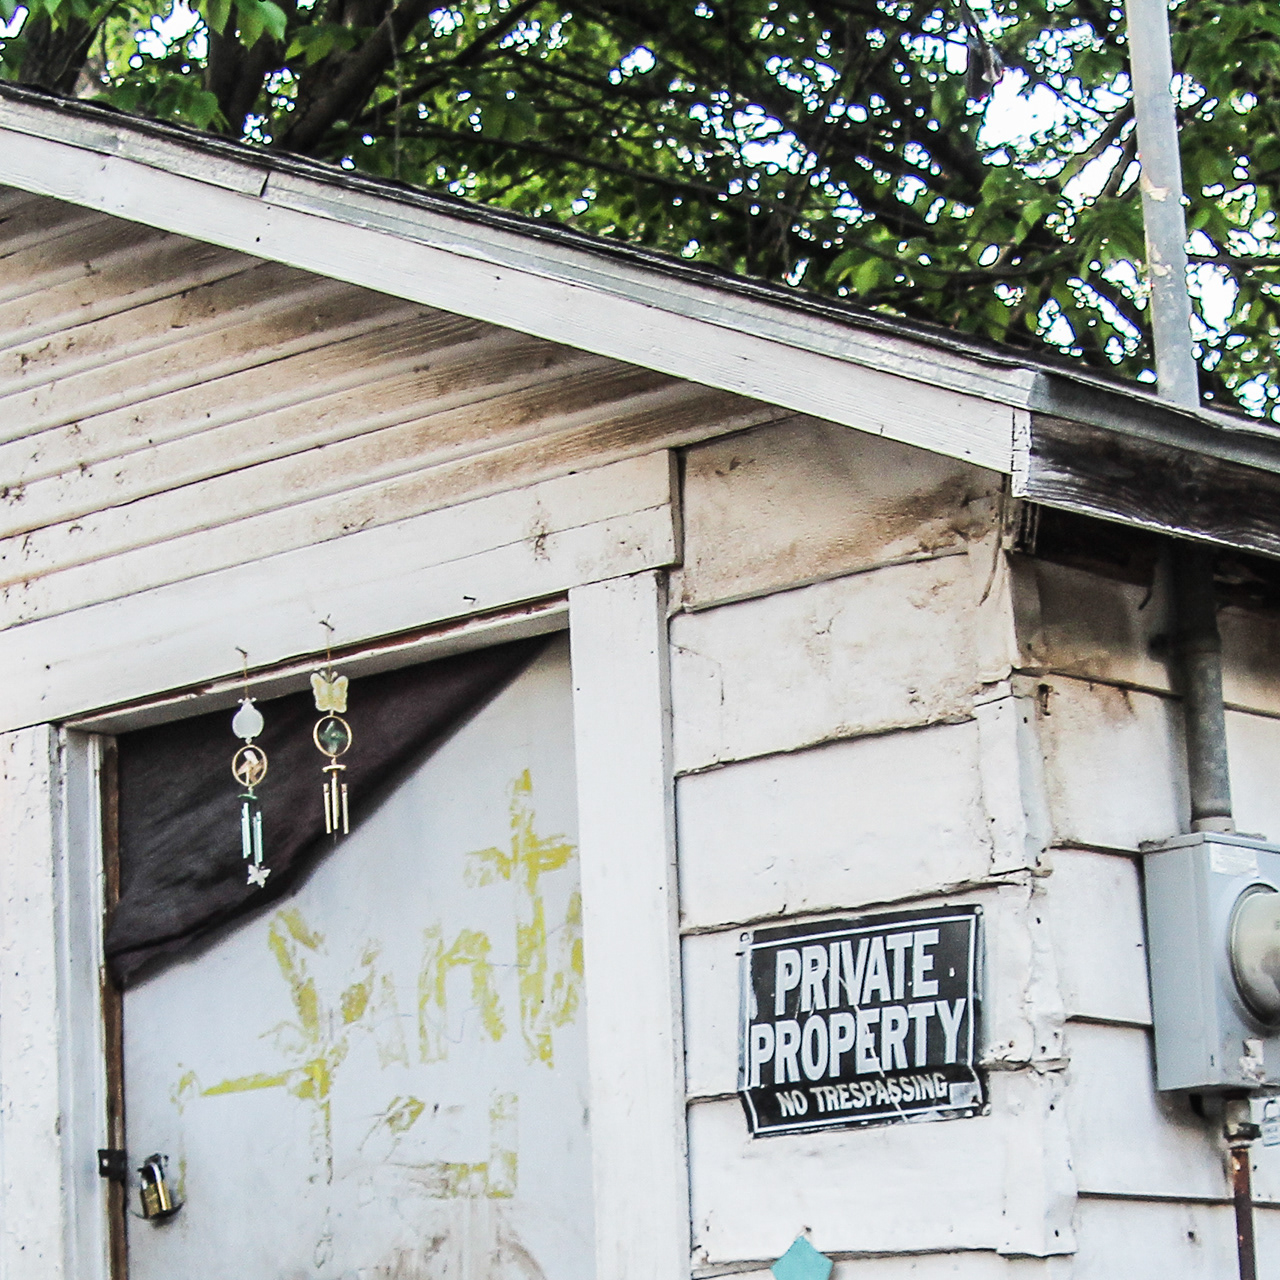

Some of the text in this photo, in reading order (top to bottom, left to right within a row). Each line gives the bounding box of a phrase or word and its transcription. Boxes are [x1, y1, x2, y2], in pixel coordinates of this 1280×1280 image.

[773, 928, 941, 1017] PRIVATE
[748, 998, 967, 1088] PROPERTY
[775, 1072, 950, 1118] NO TRESPASSING
